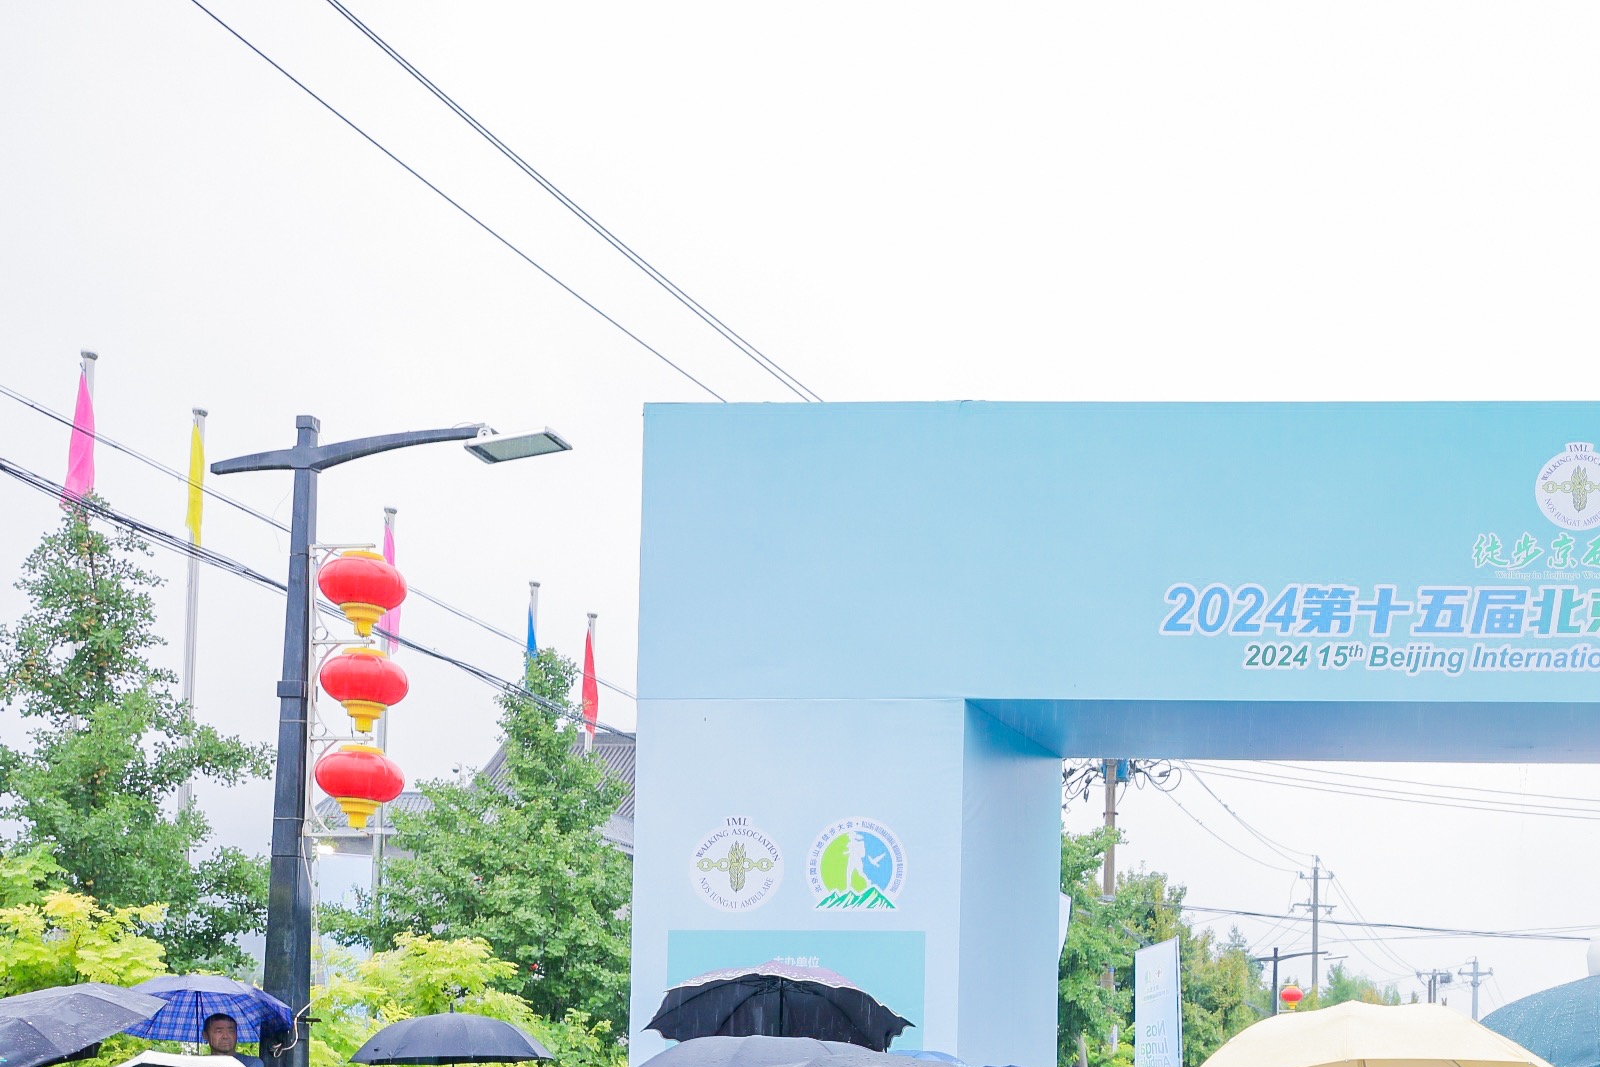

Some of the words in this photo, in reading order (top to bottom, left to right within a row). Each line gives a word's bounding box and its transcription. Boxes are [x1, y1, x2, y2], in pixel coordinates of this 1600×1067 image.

[1569, 444, 1590, 453] IML
[1541, 455, 1572, 482] WALKING
[1495, 571, 1530, 581] Walking
[1246, 645, 1308, 668] 2024
[1318, 643, 1364, 668] 15th
[1368, 644, 1465, 674] Beijing
[726, 817, 749, 827] IML
[696, 830, 729, 858] WALKING
[731, 828, 780, 862] ASSOCIATION
[740, 877, 774, 909] AMBULARE
